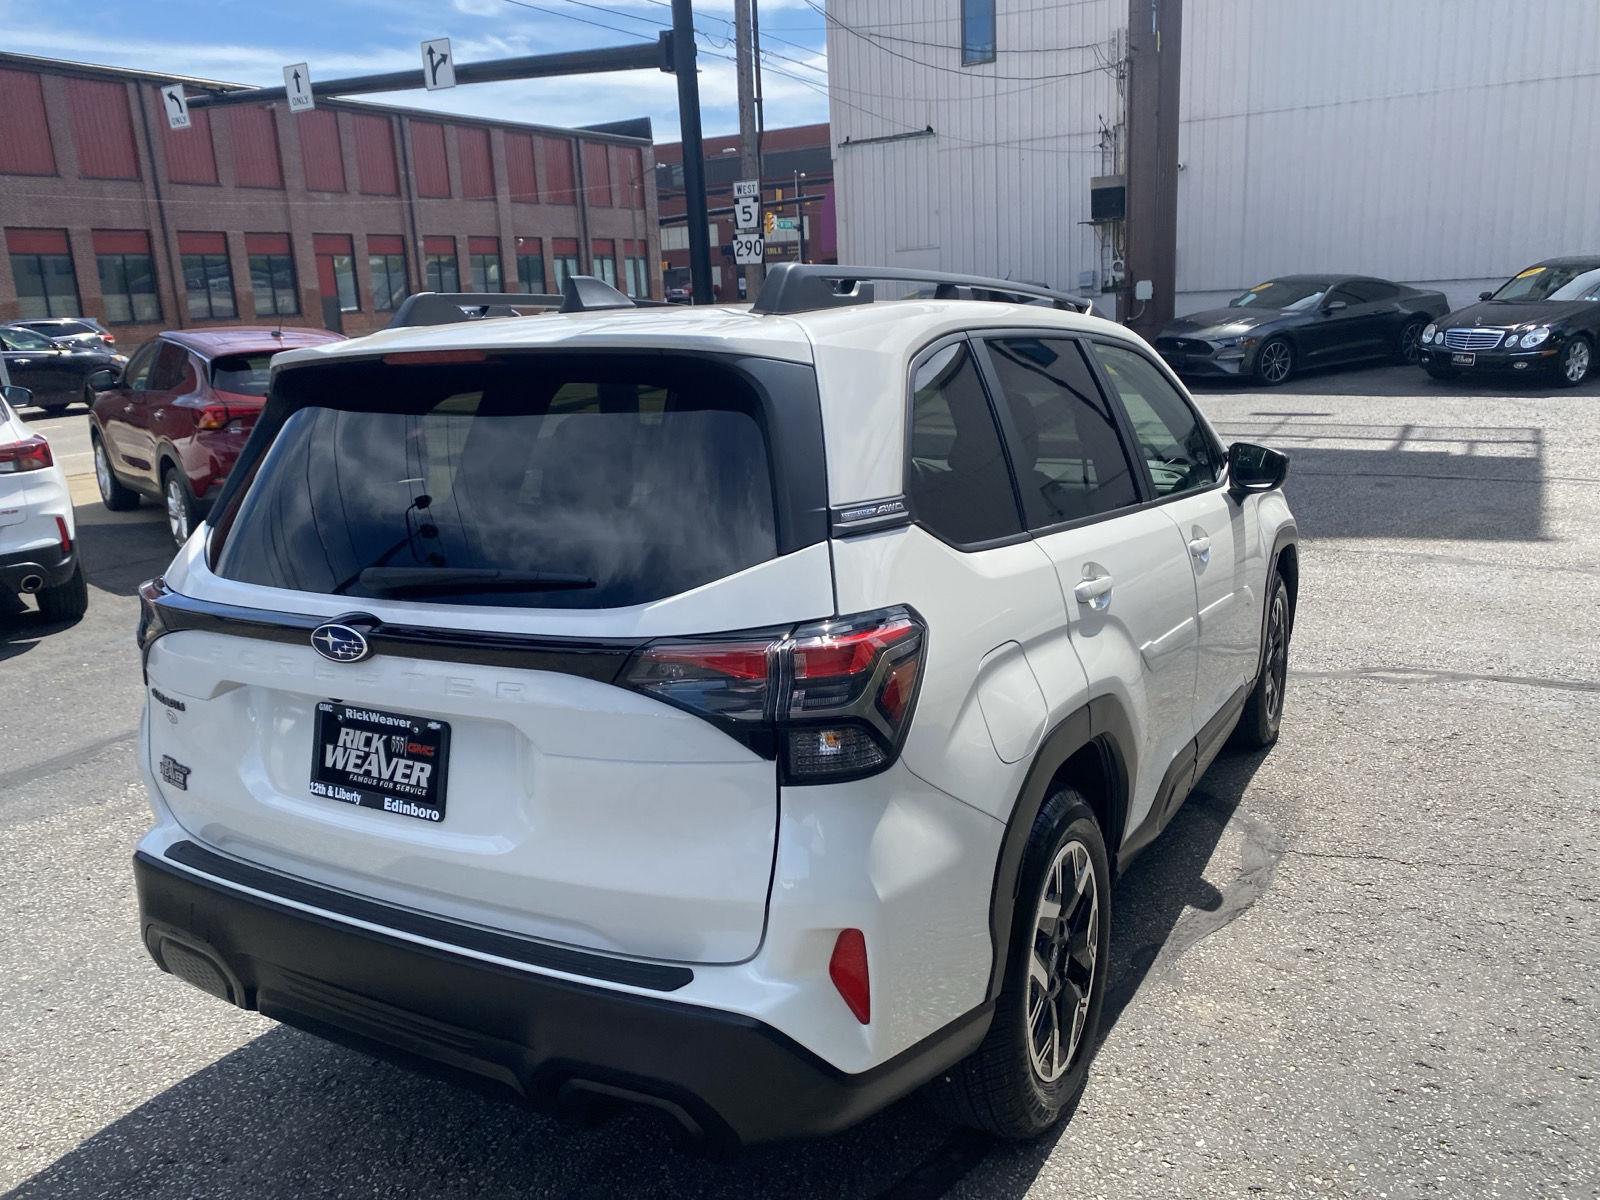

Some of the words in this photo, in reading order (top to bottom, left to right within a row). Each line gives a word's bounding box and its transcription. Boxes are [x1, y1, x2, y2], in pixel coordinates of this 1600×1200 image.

[291, 95, 309, 106] ONLY
[170, 115, 187, 126] ONLY
[736, 184, 757, 195] WEST
[742, 205, 753, 222] 5
[736, 239, 762, 257] 290
[318, 703, 333, 712] GMC
[345, 708, 412, 729] RickWeaver
[337, 727, 388, 755] RICK
[407, 742, 434, 757] GMC
[324, 743, 432, 788] WEAVER
[309, 782, 326, 795] 12th
[327, 786, 334, 797] &
[334, 786, 362, 805] Liberty
[349, 774, 377, 786] FAMOUS
[379, 780, 394, 789] FOR
[395, 784, 427, 796] SERVICE
[383, 797, 440, 821] Edinboro
